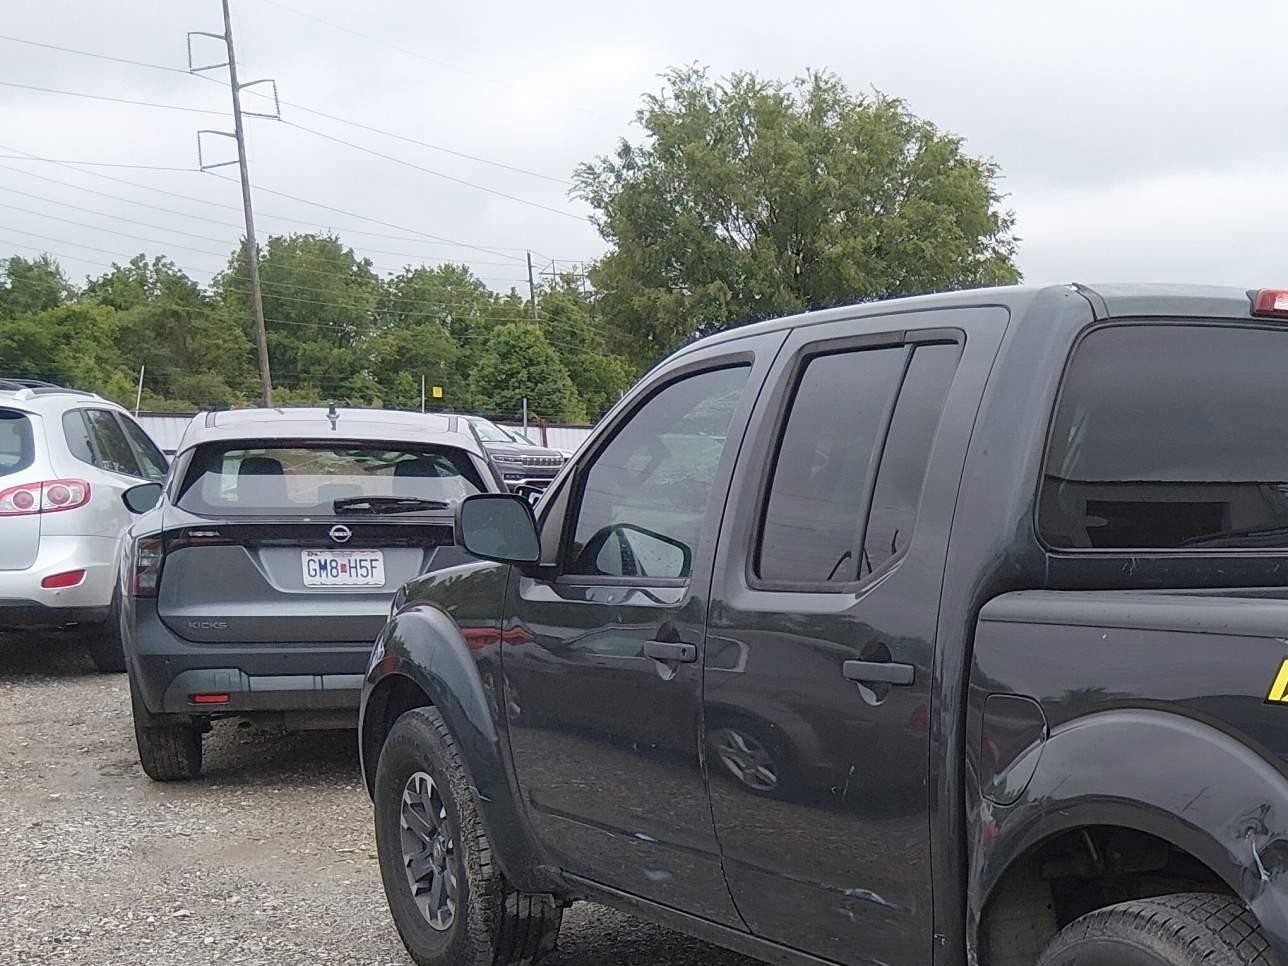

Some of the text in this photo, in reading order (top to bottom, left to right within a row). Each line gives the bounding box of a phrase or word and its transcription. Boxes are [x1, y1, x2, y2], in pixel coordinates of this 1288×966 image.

[307, 559, 379, 578] GM8 H5F
[188, 621, 228, 629] KICKS
